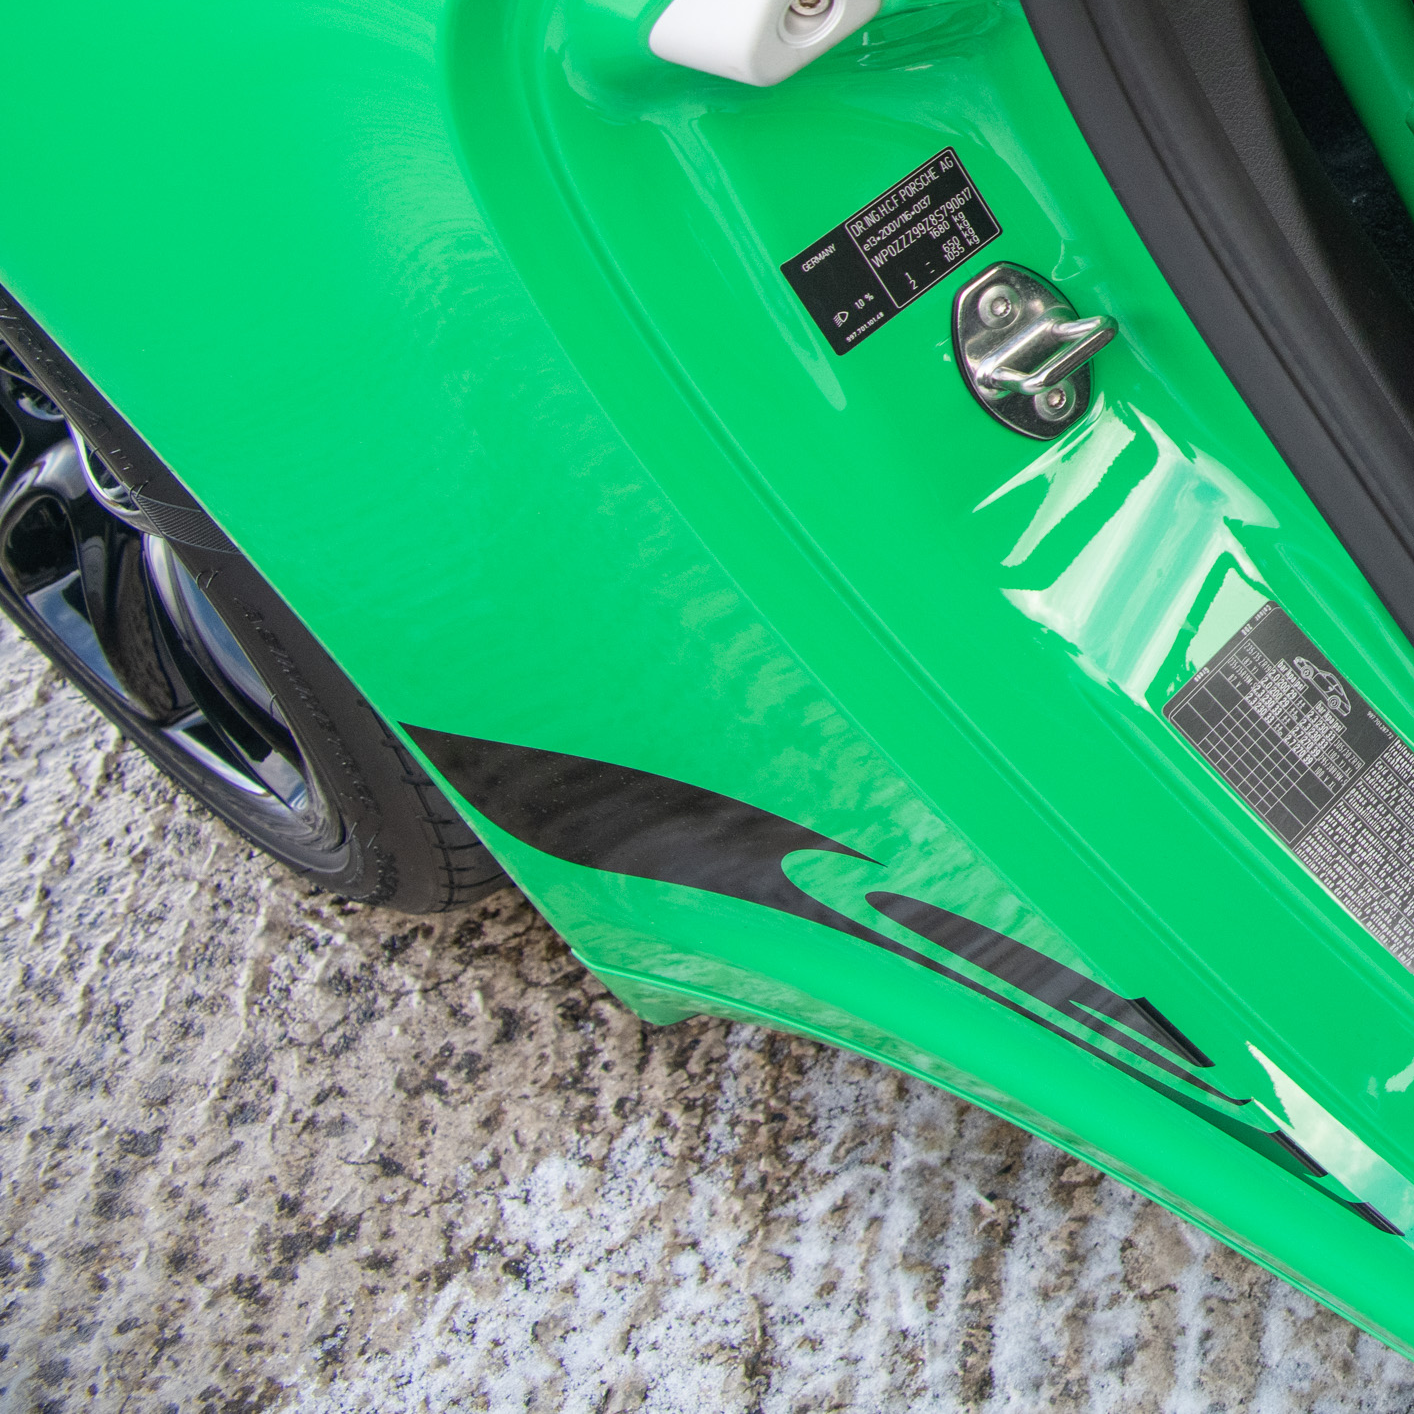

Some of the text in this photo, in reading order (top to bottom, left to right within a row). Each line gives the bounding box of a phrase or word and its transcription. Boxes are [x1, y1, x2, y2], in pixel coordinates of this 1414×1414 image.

[939, 156, 954, 172] AG
[929, 211, 966, 239] 1680 kg
[942, 236, 960, 252] 650
[961, 227, 975, 238] kg
[956, 219, 970, 231] kg
[802, 243, 837, 273] GERMANY
[910, 280, 919, 290] 2
[944, 246, 965, 263] 1055
[966, 235, 980, 246] kg
[864, 293, 874, 302] %
[1276, 660, 1306, 692] bar kpa psi
[1252, 684, 1265, 697] 2.3
[1261, 693, 1275, 708] 230
[1271, 703, 1282, 716] 33
[1291, 726, 1304, 739] 2.7
[1300, 735, 1314, 750] 270
[1310, 745, 1321, 757] 39
[1260, 676, 1273, 690] 2.0
[1269, 685, 1283, 700] 200
[1279, 696, 1290, 708] 29
[1298, 718, 1311, 731] 2.3
[1307, 727, 1321, 742] 230
[1317, 737, 1328, 749] 33
[1267, 668, 1281, 682] 2.0
[1276, 678, 1290, 692] 200
[1286, 688, 1298, 700] 29
[1306, 710, 1319, 724] 2.3
[1314, 719, 1329, 734] 230
[1324, 729, 1336, 742] 33
[1314, 702, 1344, 733] bar kpa psi
[1245, 692, 1258, 705] 2.3
[1253, 701, 1268, 716] 230
[1263, 711, 1275, 723] 33
[1283, 734, 1296, 747] 2.7
[1292, 743, 1306, 758] 270
[1302, 753, 1313, 765] 39
